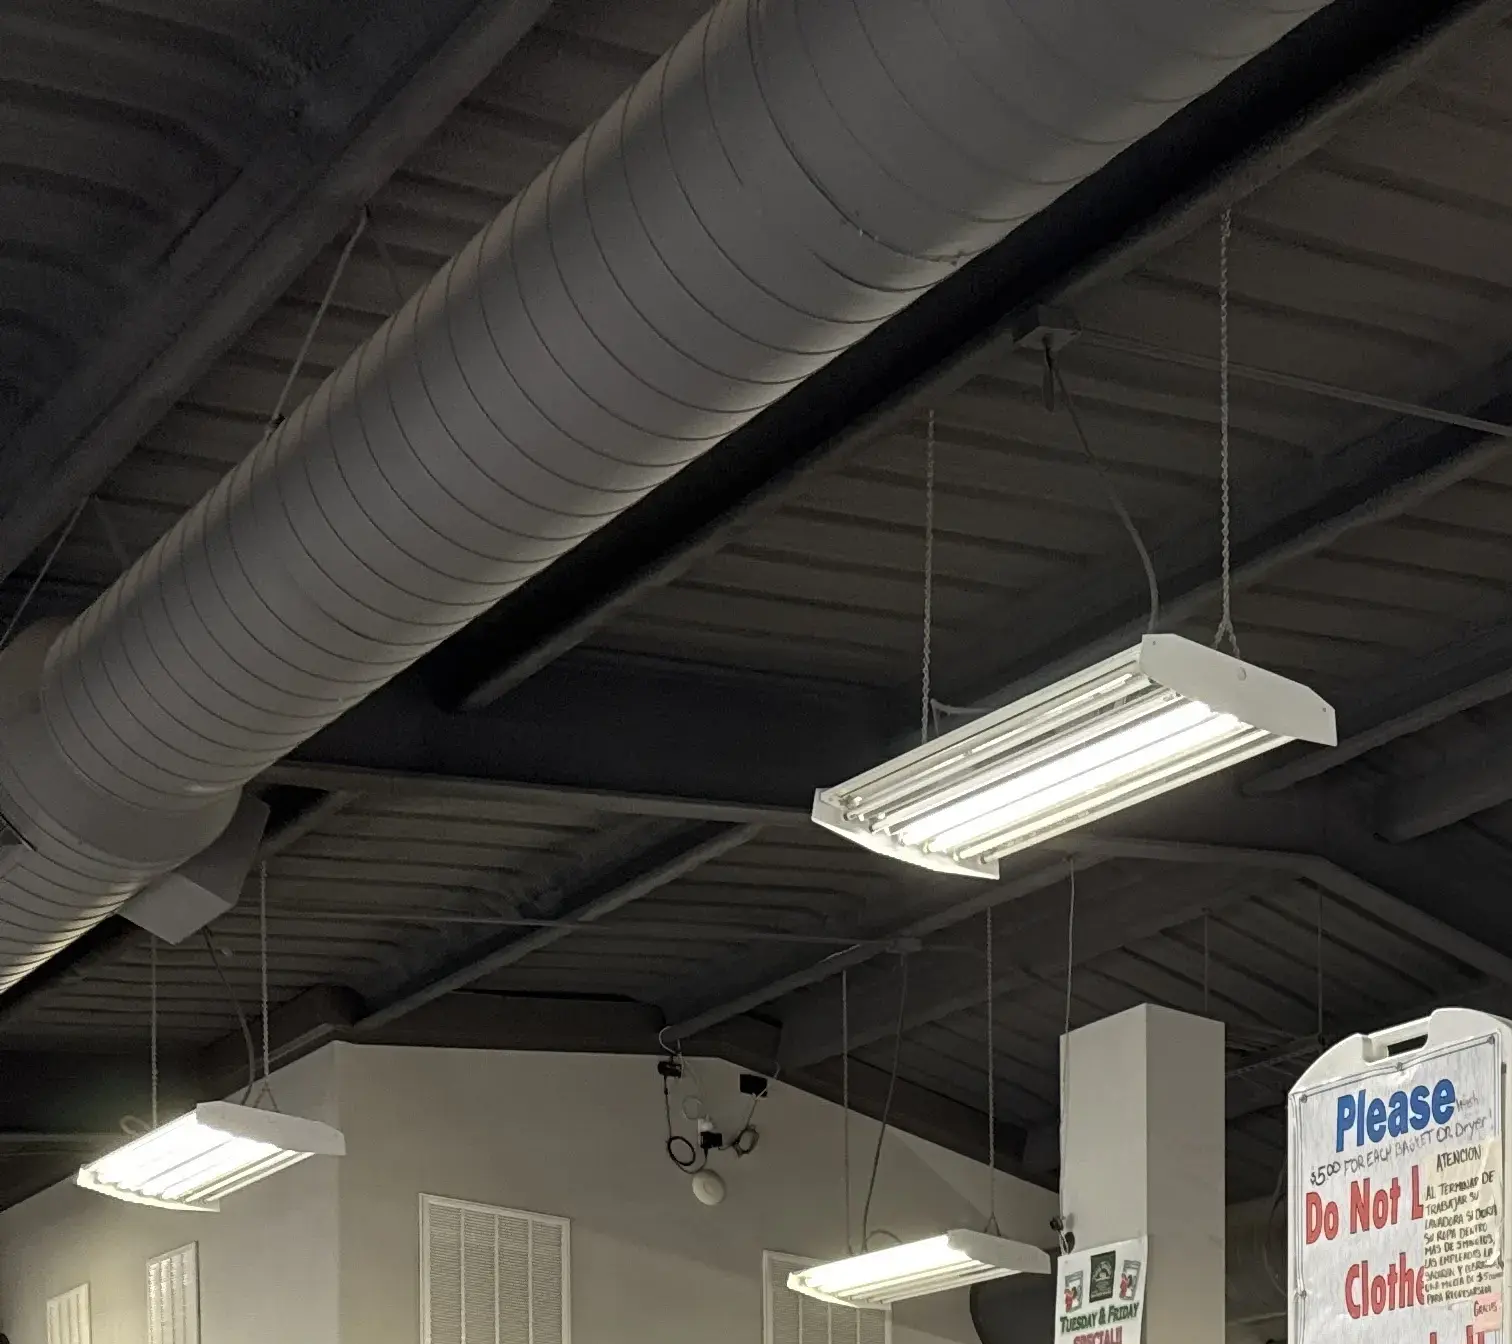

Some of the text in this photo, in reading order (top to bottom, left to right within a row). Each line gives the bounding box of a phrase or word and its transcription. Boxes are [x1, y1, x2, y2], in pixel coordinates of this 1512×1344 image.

[1336, 1078, 1456, 1153] Please
[1344, 1154, 1365, 1176] FOR
[1367, 1145, 1392, 1168] EACH
[1436, 1125, 1453, 1143] OR
[1436, 1144, 1482, 1173] ATENCION
[1425, 1185, 1436, 1201] AL
[1481, 1170, 1495, 1185] DE
[1469, 1190, 1479, 1202] SU
[1305, 1191, 1339, 1245] Do
[1350, 1177, 1401, 1235] Not
[1466, 1209, 1474, 1222] SI
[1424, 1241, 1454, 1256] MAS DE
[1060, 1302, 1139, 1334] TUESDAY & FRIDAY
